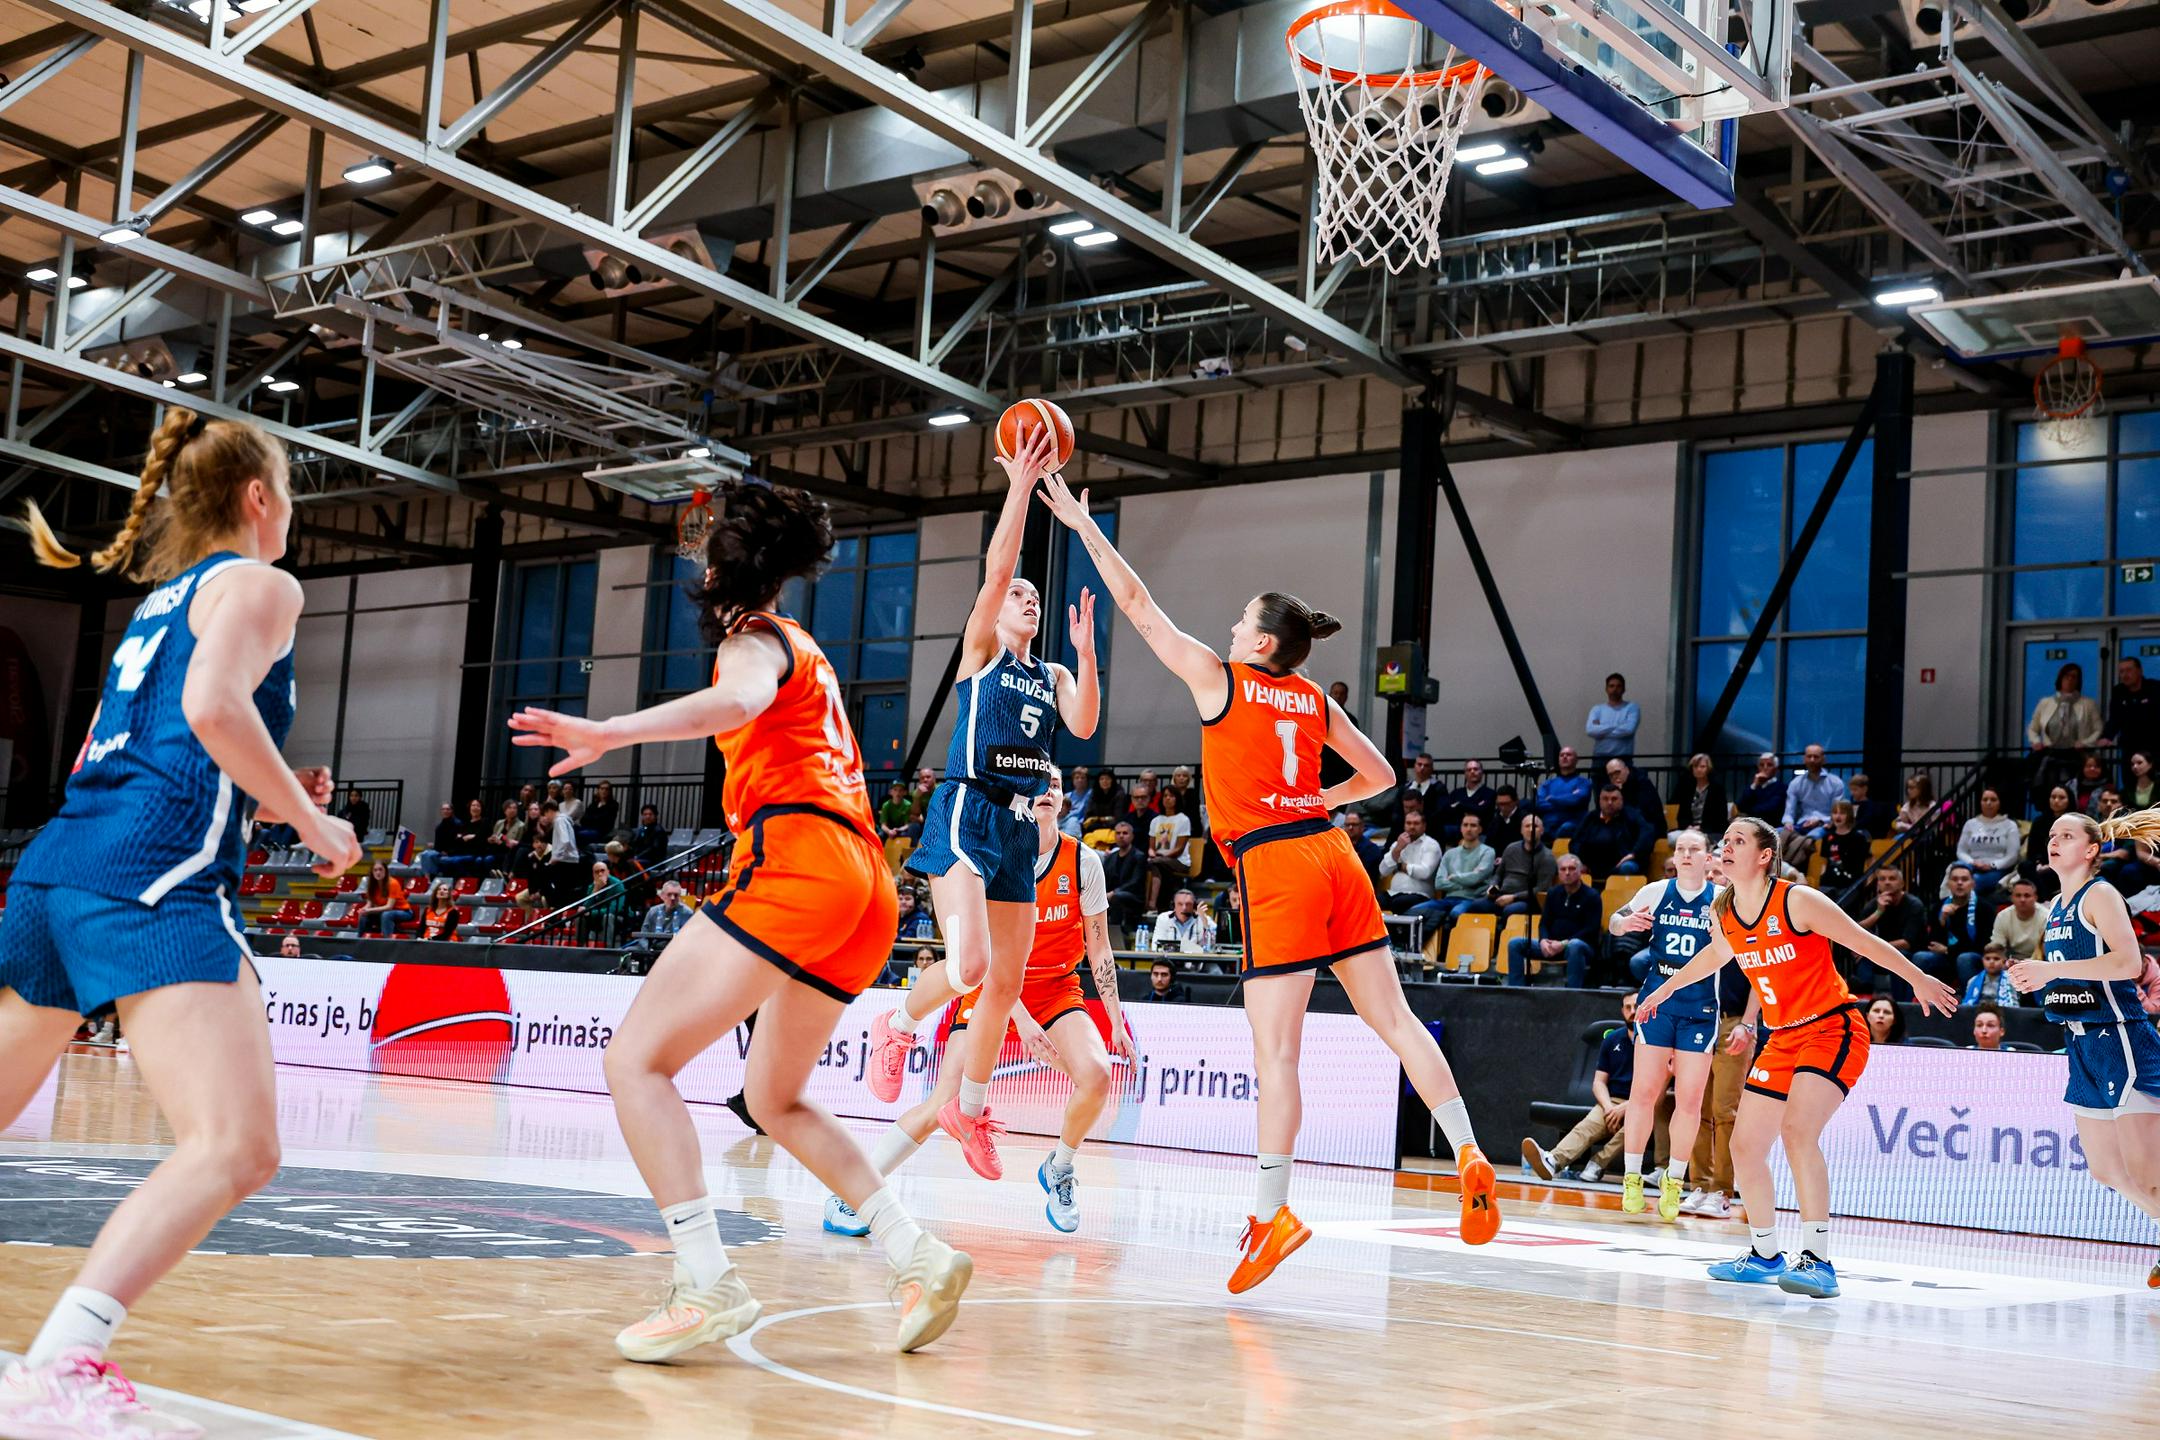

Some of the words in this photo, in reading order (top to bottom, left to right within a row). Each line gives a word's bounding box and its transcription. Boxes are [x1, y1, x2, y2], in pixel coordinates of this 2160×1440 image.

[1000, 672, 1057, 711] SLOVENIJ
[1020, 703, 1043, 739] 5
[1275, 720, 1298, 787] 1
[1036, 904, 1068, 923] LAND
[1659, 913, 1711, 932] SLOVENIJA
[1665, 932, 1697, 957] 20
[1757, 976, 1778, 1005] 5
[281, 1002, 318, 1027] nas
[320, 995, 350, 1038] je,
[1867, 1104, 1971, 1161] Več
[1992, 1126, 2089, 1171] nas
